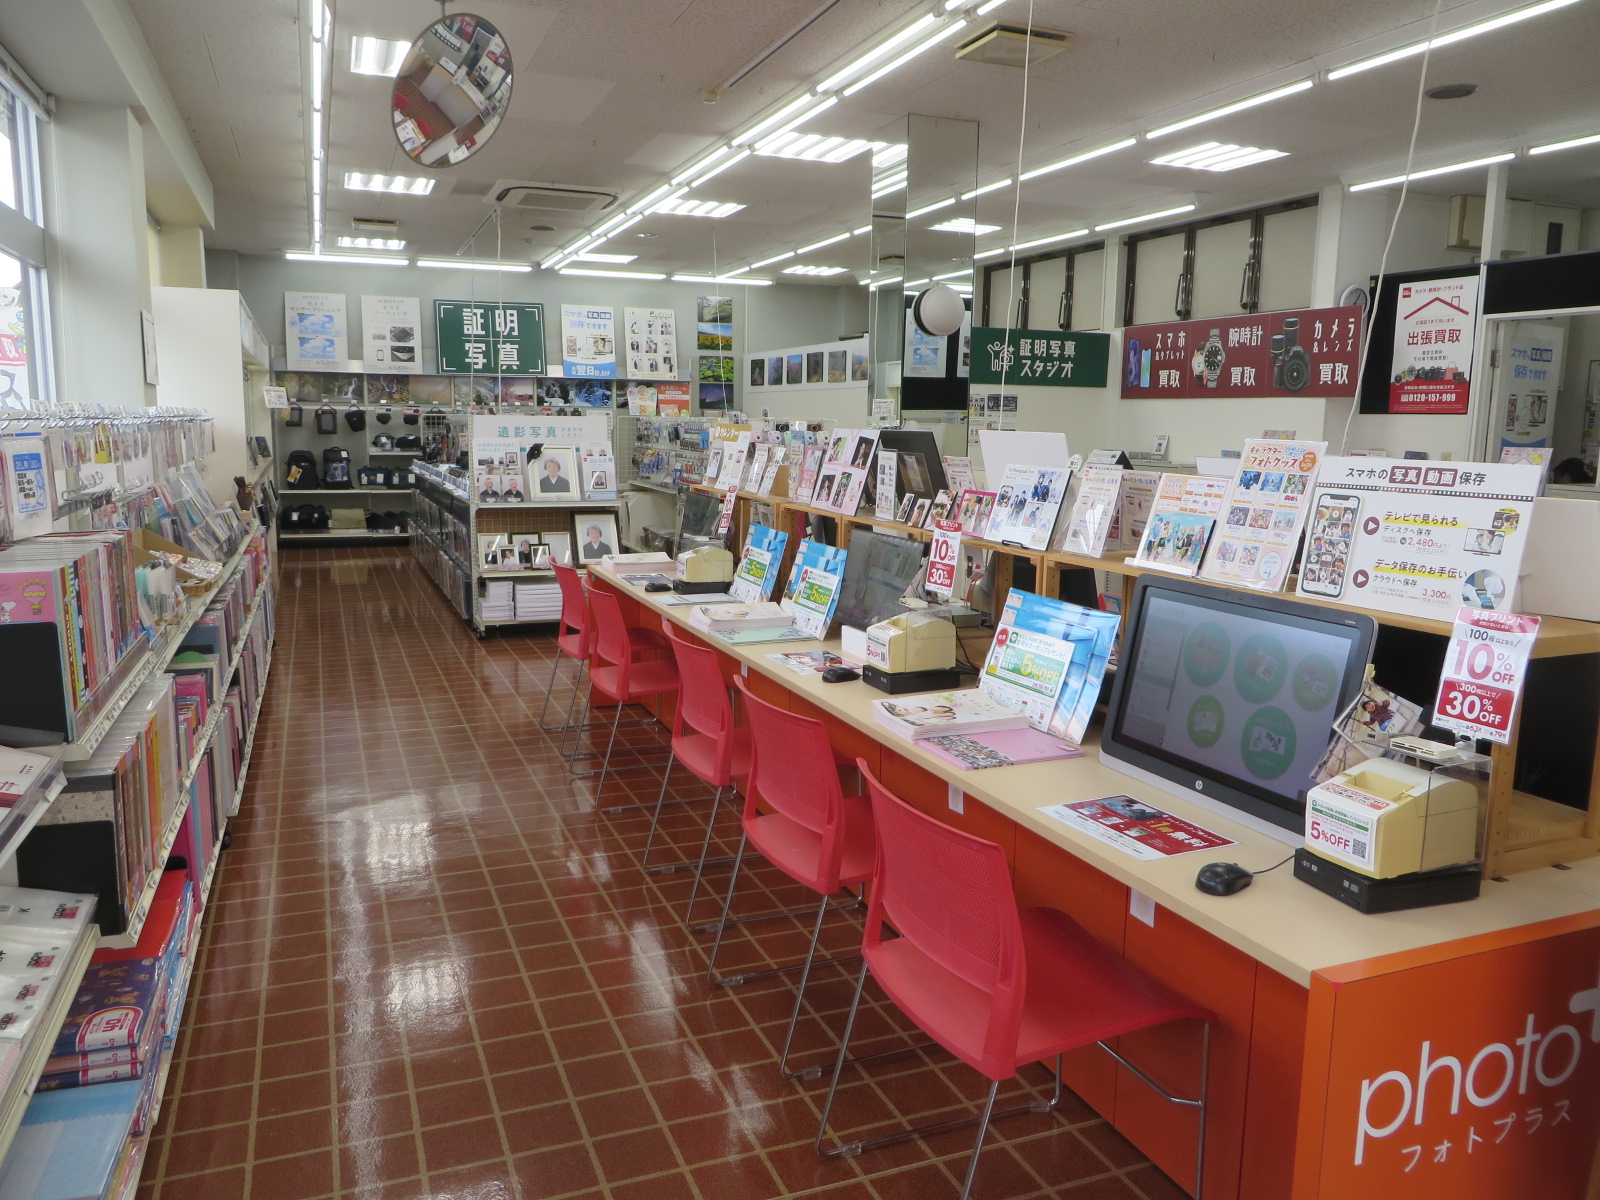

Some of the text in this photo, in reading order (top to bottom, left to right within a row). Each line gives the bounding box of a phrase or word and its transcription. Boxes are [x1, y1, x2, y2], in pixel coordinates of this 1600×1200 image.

[462, 308, 519, 336] 証明
[1314, 317, 1356, 340] カメラ
[1156, 331, 1186, 349] スマホ
[1228, 325, 1264, 347] 腕時計
[1313, 338, 1354, 353] &レンズ
[1407, 329, 1462, 346] 出張買取
[465, 342, 520, 370] 写真
[1019, 338, 1077, 358] 証明写真
[1155, 350, 1186, 361] &タブレット
[1019, 359, 1075, 378] スタジオ
[1230, 366, 1256, 387] 買取
[1319, 362, 1349, 385] 買取
[1158, 369, 1181, 388] 買取
[497, 426, 558, 438] 遺影写真
[1385, 511, 1459, 527] テレビで見られる
[1383, 525, 1432, 537] ディスクへ保存
[934, 538, 955, 561] 10%
[1407, 536, 1448, 550] 2,480円より
[1375, 558, 1468, 579] データ保存のお手伝い
[1372, 574, 1418, 588] クラウドへ保存
[1421, 588, 1452, 600] 3,300円
[1471, 609, 1524, 626] 写真プリント
[1020, 653, 1061, 683] 5%OFF
[1453, 639, 1513, 681] 10%
[1491, 671, 1515, 685] OFF
[1445, 690, 1494, 720] 30%
[1479, 711, 1502, 725] OFF
[1311, 820, 1351, 850] 5%OFF
[1354, 1013, 1581, 1167] photo
[1401, 1099, 1571, 1174] フォトプラス
